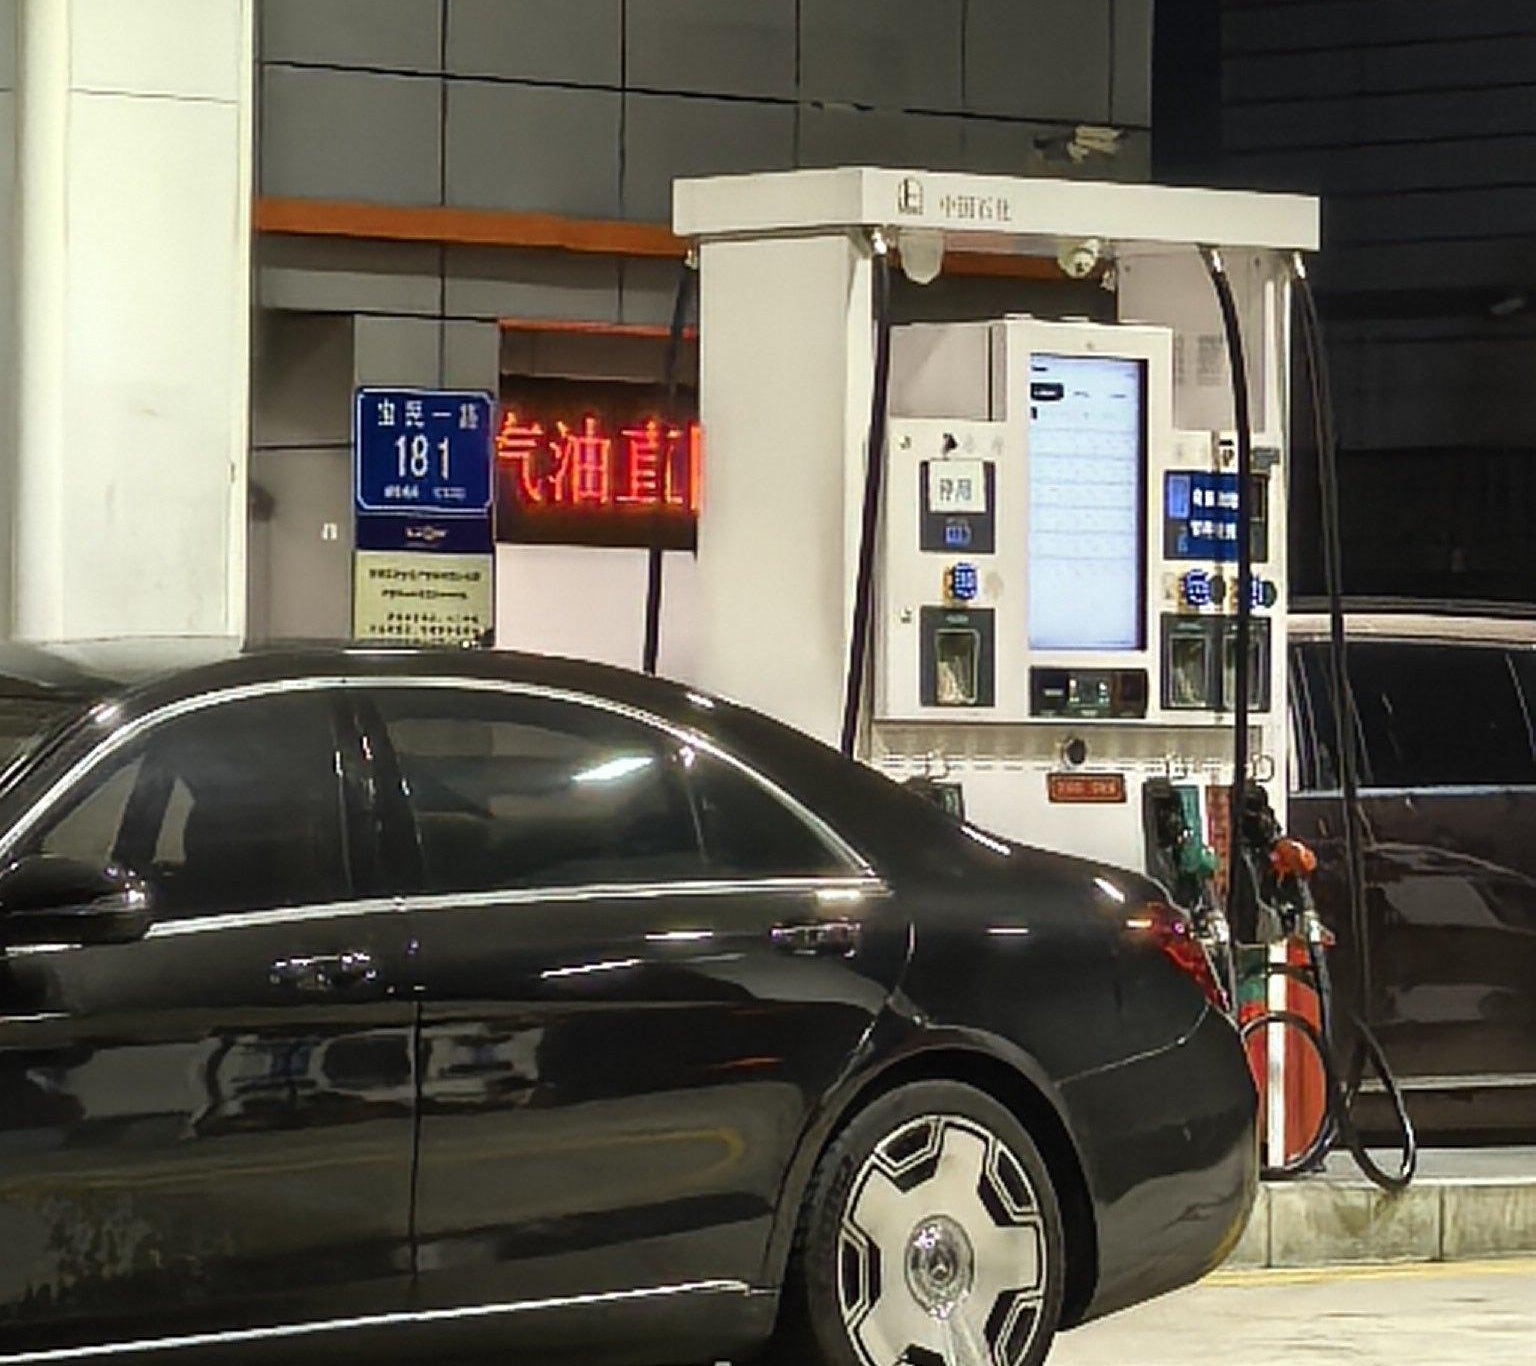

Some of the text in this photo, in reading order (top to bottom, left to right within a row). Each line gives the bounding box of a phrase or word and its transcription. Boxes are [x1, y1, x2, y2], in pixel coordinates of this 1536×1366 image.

[940, 195, 1011, 221] 中国石化
[395, 435, 449, 480] 181
